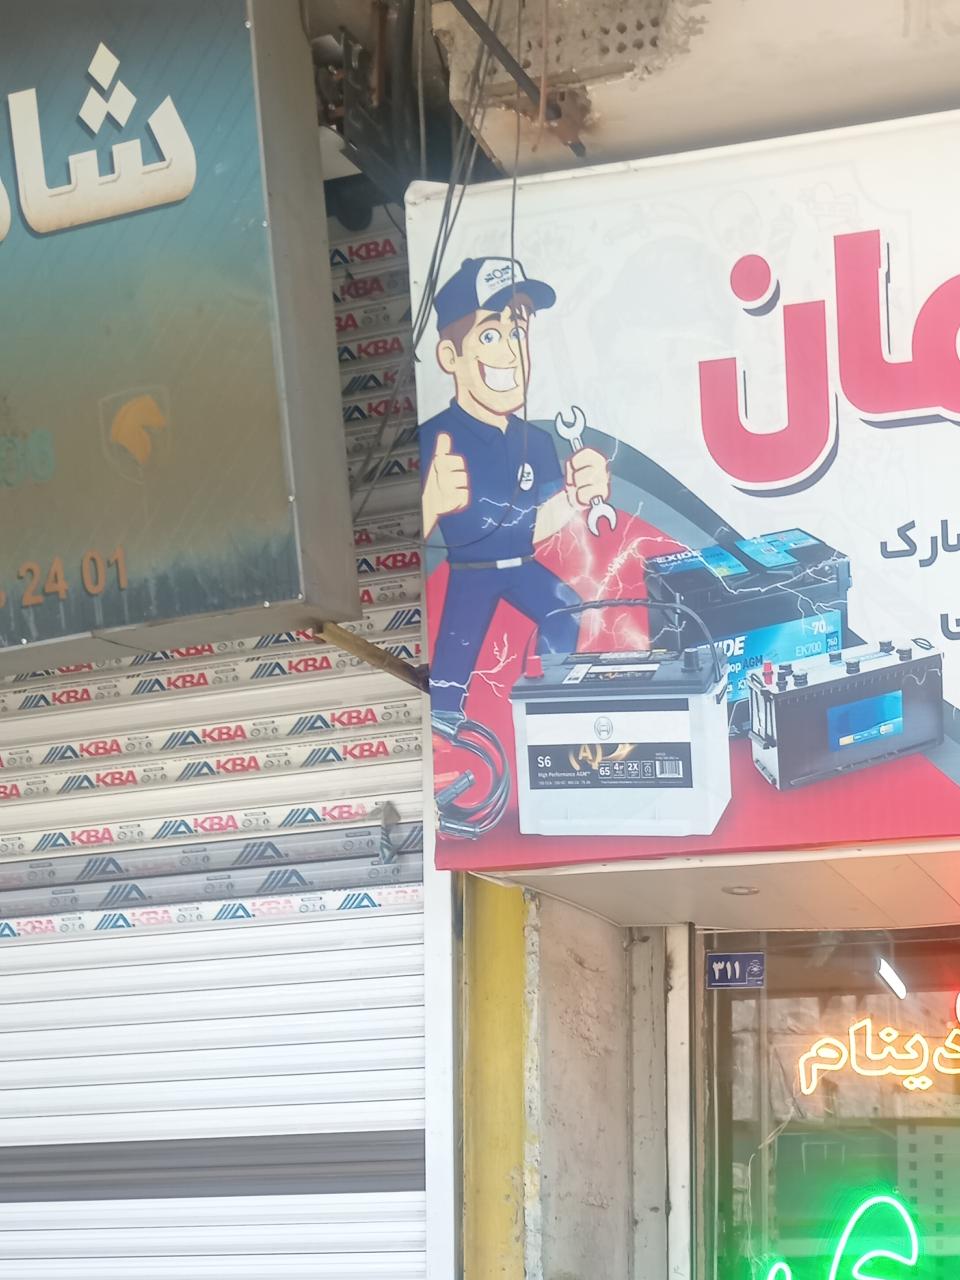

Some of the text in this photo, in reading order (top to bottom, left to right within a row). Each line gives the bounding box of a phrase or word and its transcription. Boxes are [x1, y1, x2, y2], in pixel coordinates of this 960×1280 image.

[0, 42, 198, 243] شا
[18, 554, 69, 608] 24
[536, 755, 552, 769] S6
[712, 959, 741, 980] ۳۱۱
